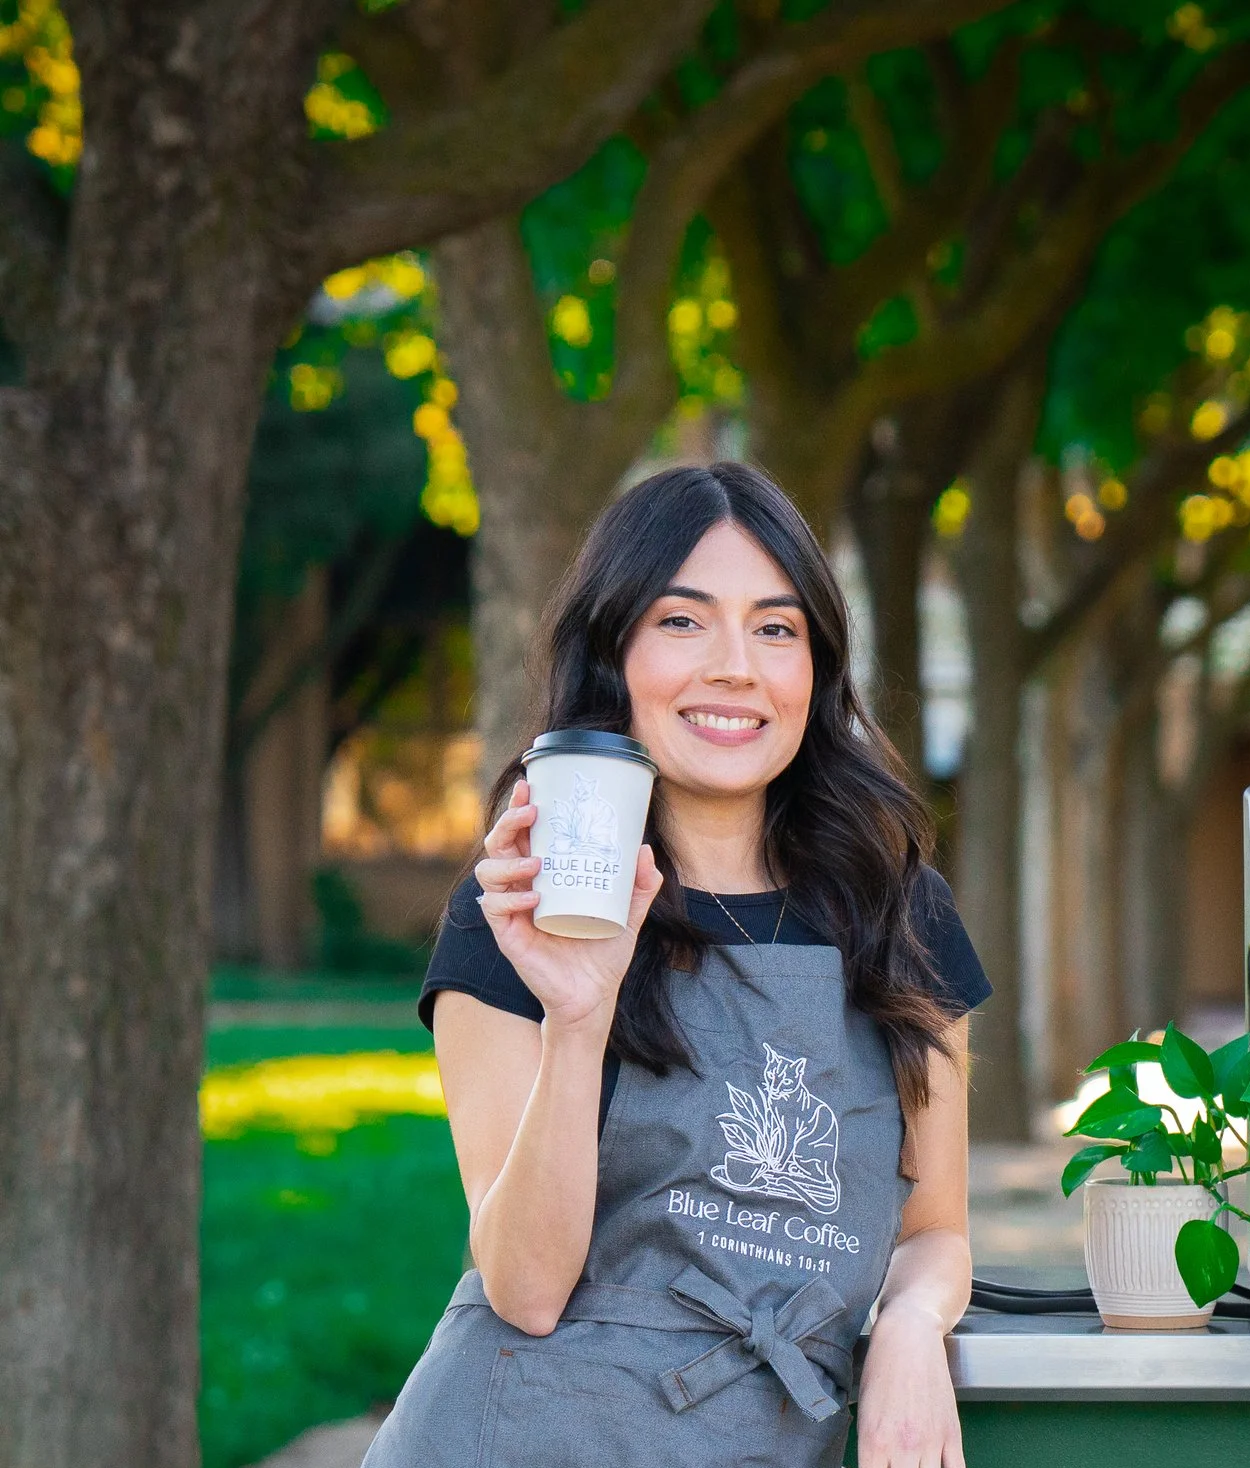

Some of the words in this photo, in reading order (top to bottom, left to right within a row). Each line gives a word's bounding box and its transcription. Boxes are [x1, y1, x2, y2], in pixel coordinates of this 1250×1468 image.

[543, 857, 579, 872] BLUE
[584, 858, 620, 876] LEAF
[552, 872, 611, 891] COFFEE
[667, 1189, 720, 1221] Blue
[725, 1200, 780, 1234] Leaf
[784, 1216, 860, 1254] Coffee
[697, 1231, 705, 1245] 1
[711, 1234, 792, 1266] CORINTHIANS
[798, 1255, 831, 1273] 10:31
